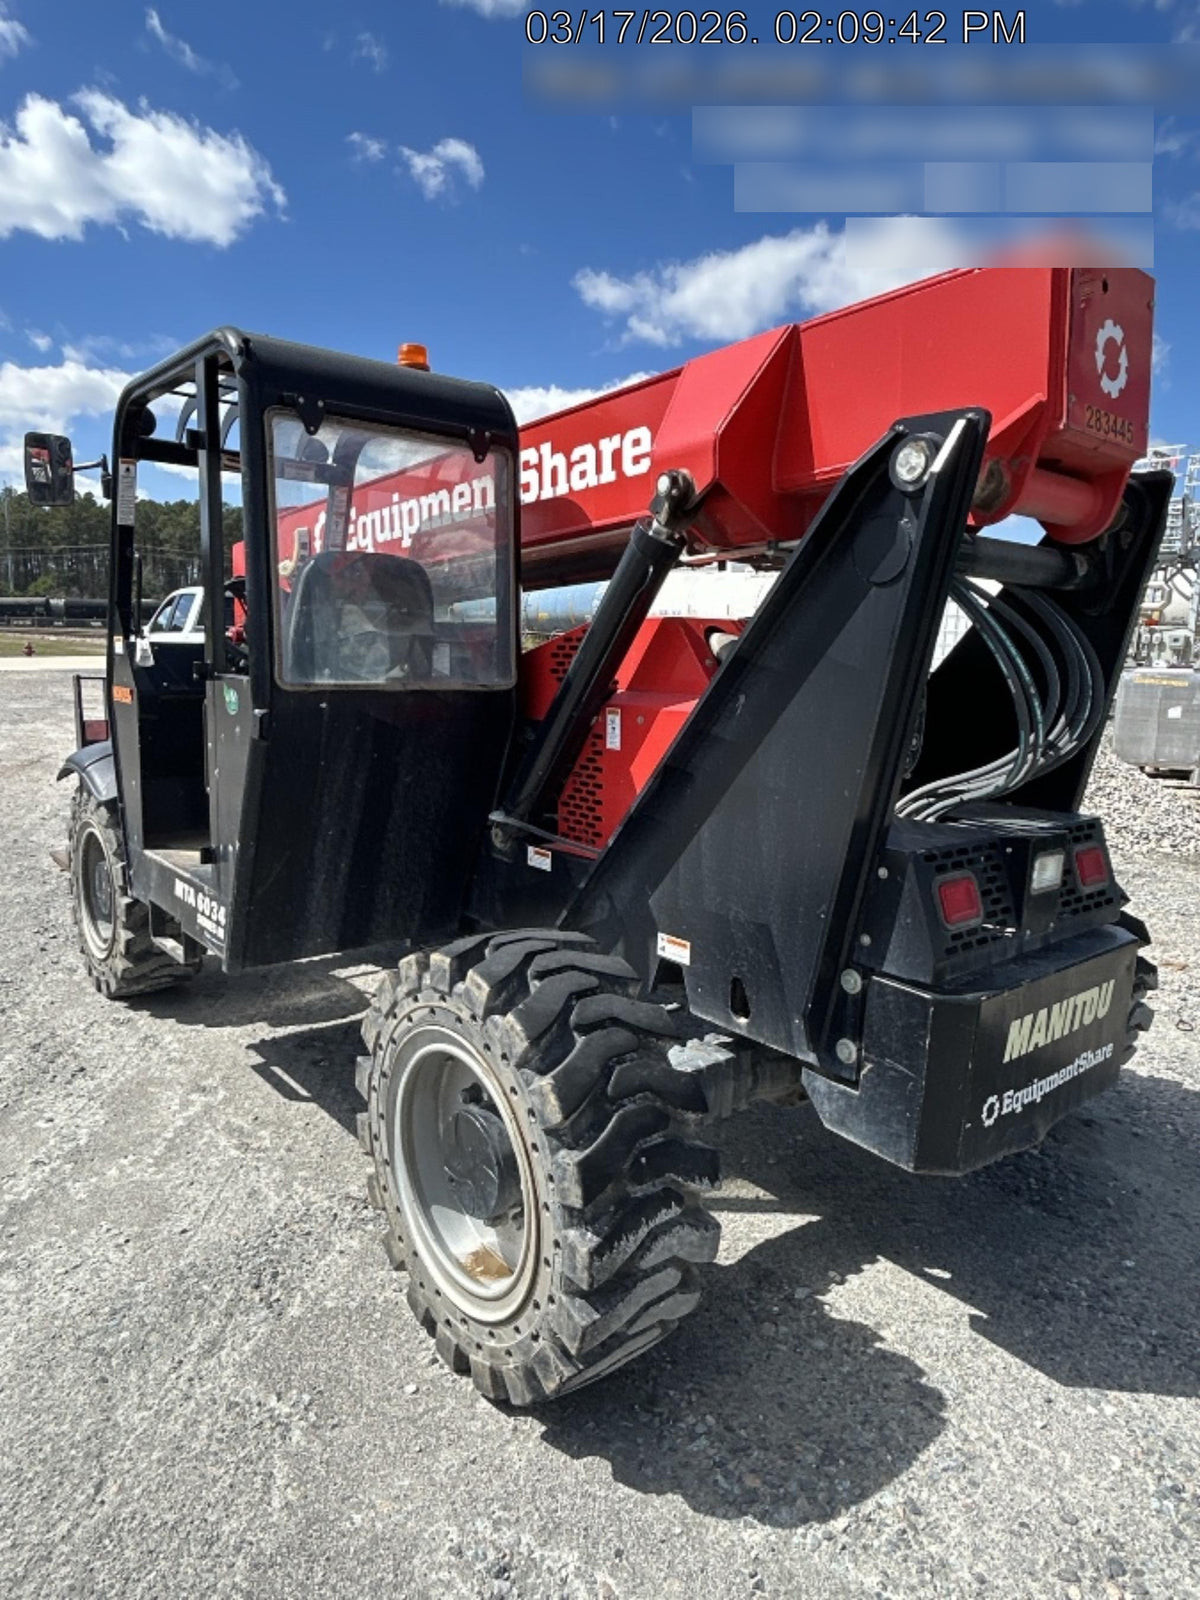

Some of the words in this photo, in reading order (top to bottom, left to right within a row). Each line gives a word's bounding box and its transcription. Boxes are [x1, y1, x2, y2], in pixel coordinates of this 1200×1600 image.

[1086, 405, 1134, 444] 283445
[174, 878, 196, 908] MTA
[197, 891, 227, 927] 6034
[1002, 979, 1116, 1064] MANITOU
[1001, 1043, 1114, 1116] EquipmentShare
